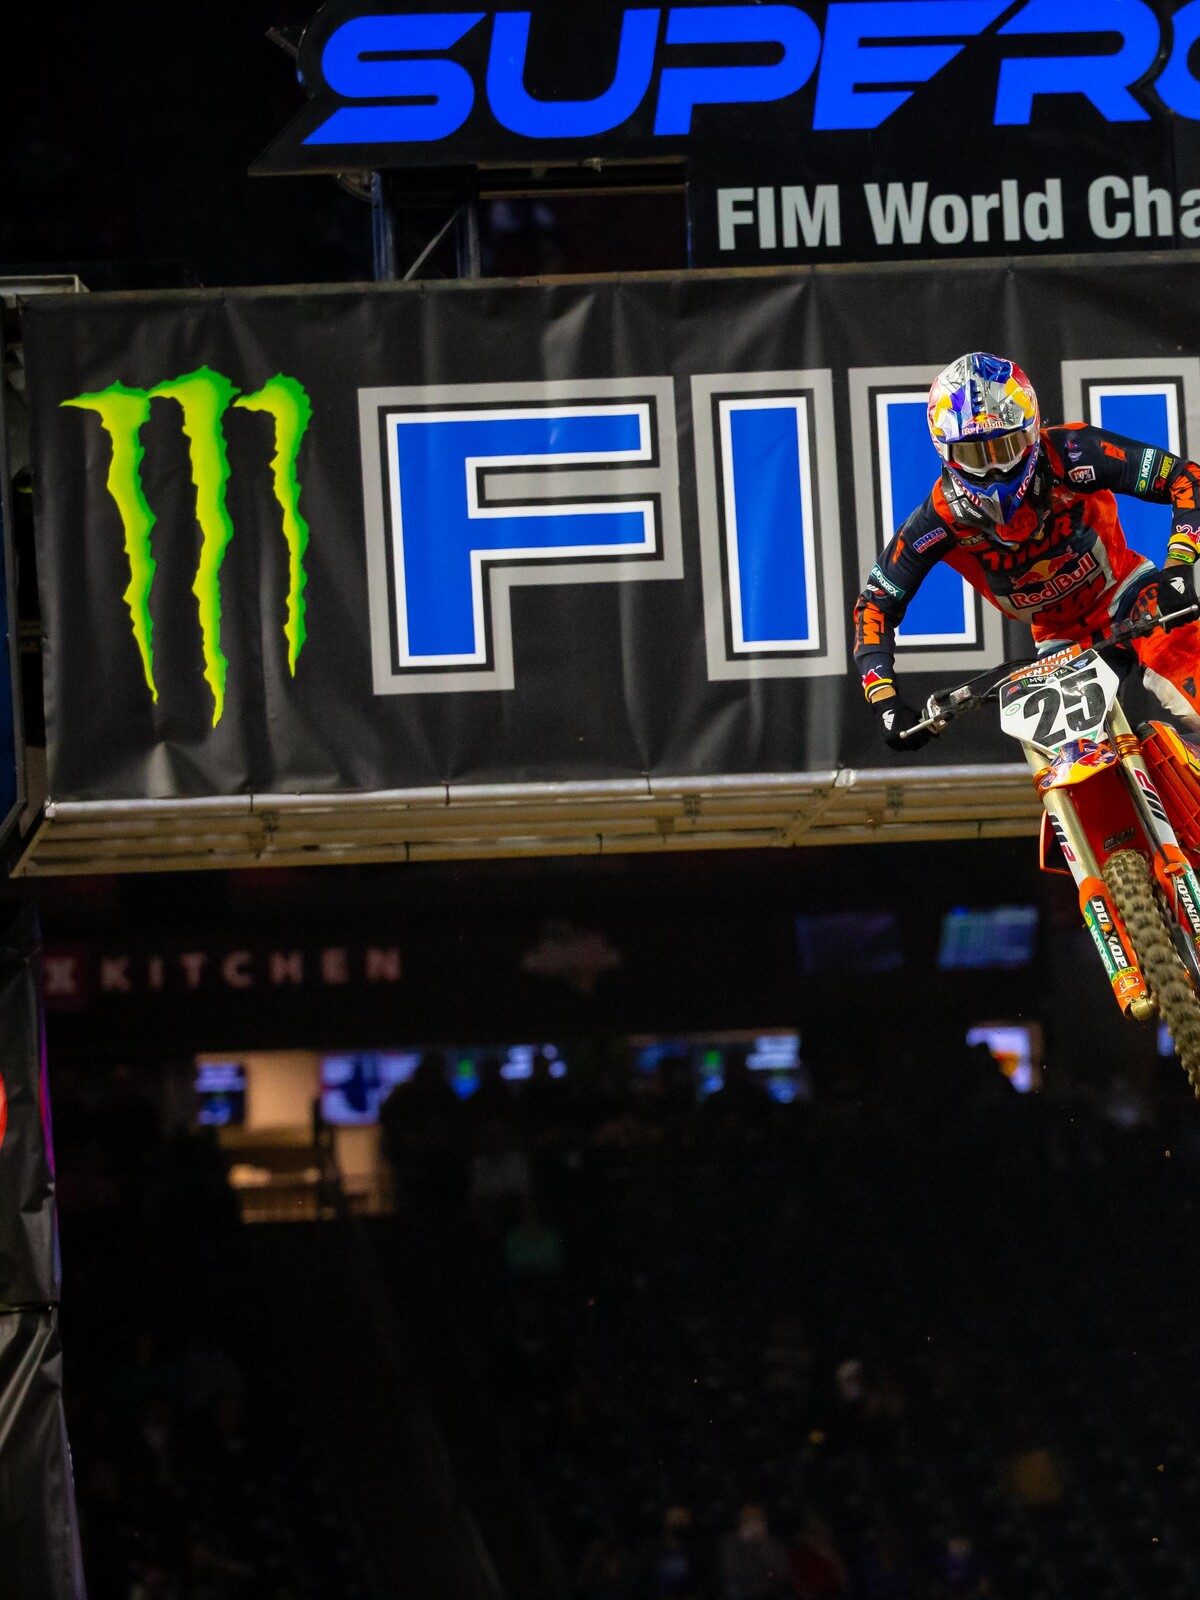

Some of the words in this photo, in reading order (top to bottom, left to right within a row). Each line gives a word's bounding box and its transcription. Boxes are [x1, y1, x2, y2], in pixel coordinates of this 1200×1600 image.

[717, 184, 841, 251] FIM
[863, 178, 1064, 246] World
[871, 565, 900, 597] MOTOREX
[1009, 580, 1059, 608] Red
[1052, 552, 1097, 593] Bull
[1023, 667, 1107, 748] 25
[102, 948, 400, 993] KITCHEN
